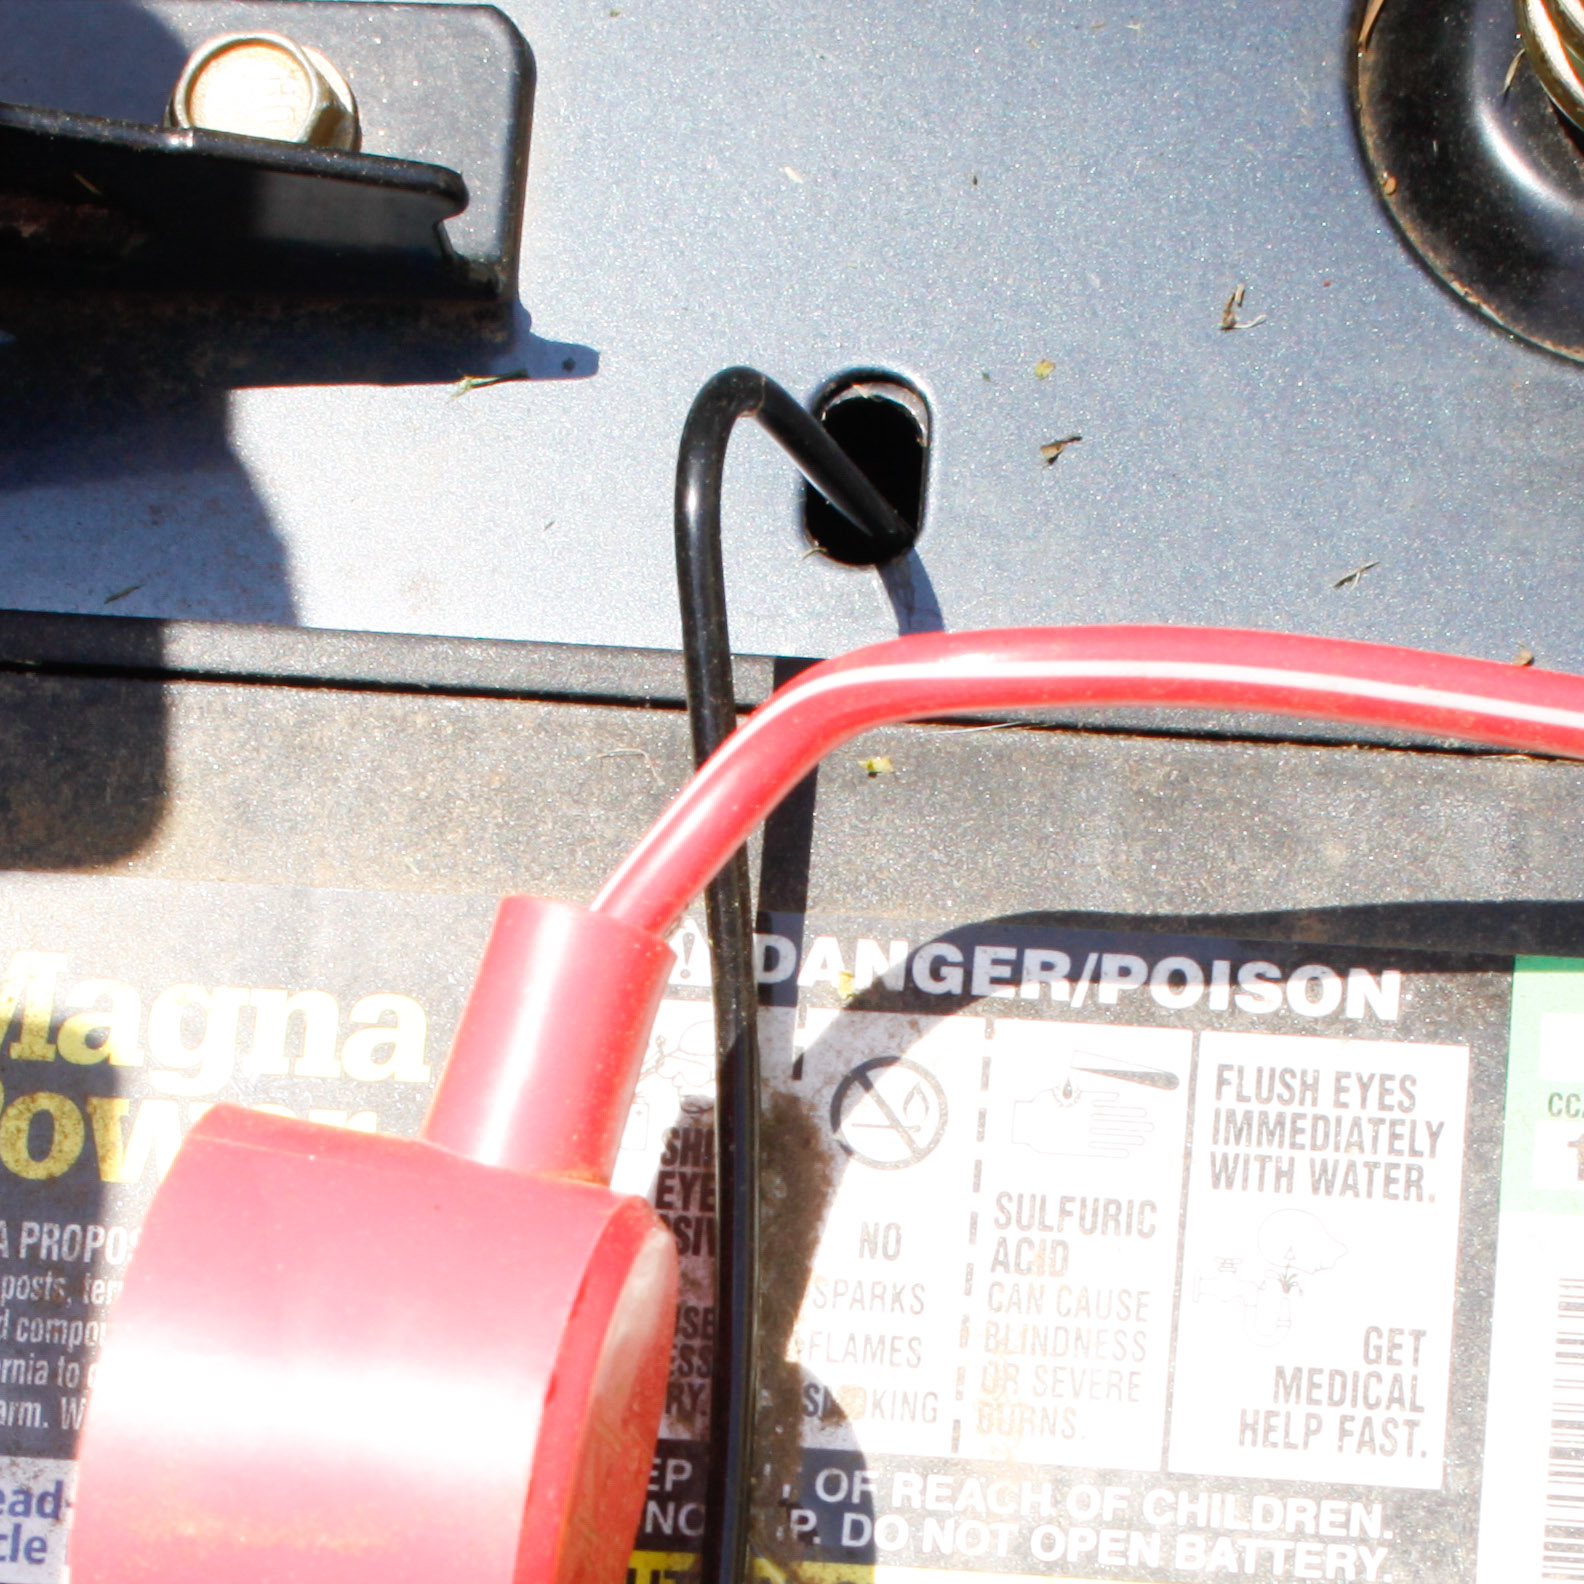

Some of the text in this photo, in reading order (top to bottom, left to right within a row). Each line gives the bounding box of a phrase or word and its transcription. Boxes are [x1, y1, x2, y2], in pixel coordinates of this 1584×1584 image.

[1215, 1064, 1417, 1113] FLUSH EYES
[1212, 1108, 1445, 1159] IMMEDIATELY
[1210, 1151, 1436, 1203] WITH WATER.
[993, 1191, 1158, 1239] SULFURIC
[858, 1221, 902, 1261] NO
[990, 1236, 1070, 1278] ACID
[0, 1270, 73, 1308] posts,
[811, 1275, 926, 1316] SPARKS
[986, 1280, 1151, 1322] CAN CAUSE
[807, 1331, 923, 1369] FLAMES
[983, 1320, 1147, 1362] BLINDNESS
[1363, 1326, 1427, 1368] GET
[57, 1356, 80, 1388] to
[1032, 1364, 1142, 1403] SEVERE
[1273, 1365, 1425, 1413] MEDICAL
[1238, 1408, 1428, 1459] HELP FAST.
[815, 1468, 879, 1504] OF
[891, 1469, 1052, 1517] REACH
[1066, 1484, 1131, 1521] OF
[1143, 1489, 1394, 1540] CHILDREN.
[841, 1511, 909, 1550] DO
[922, 1516, 1018, 1557] NOT
[1029, 1523, 1161, 1567] OPEN
[1174, 1534, 1393, 1583] BATTERY.
